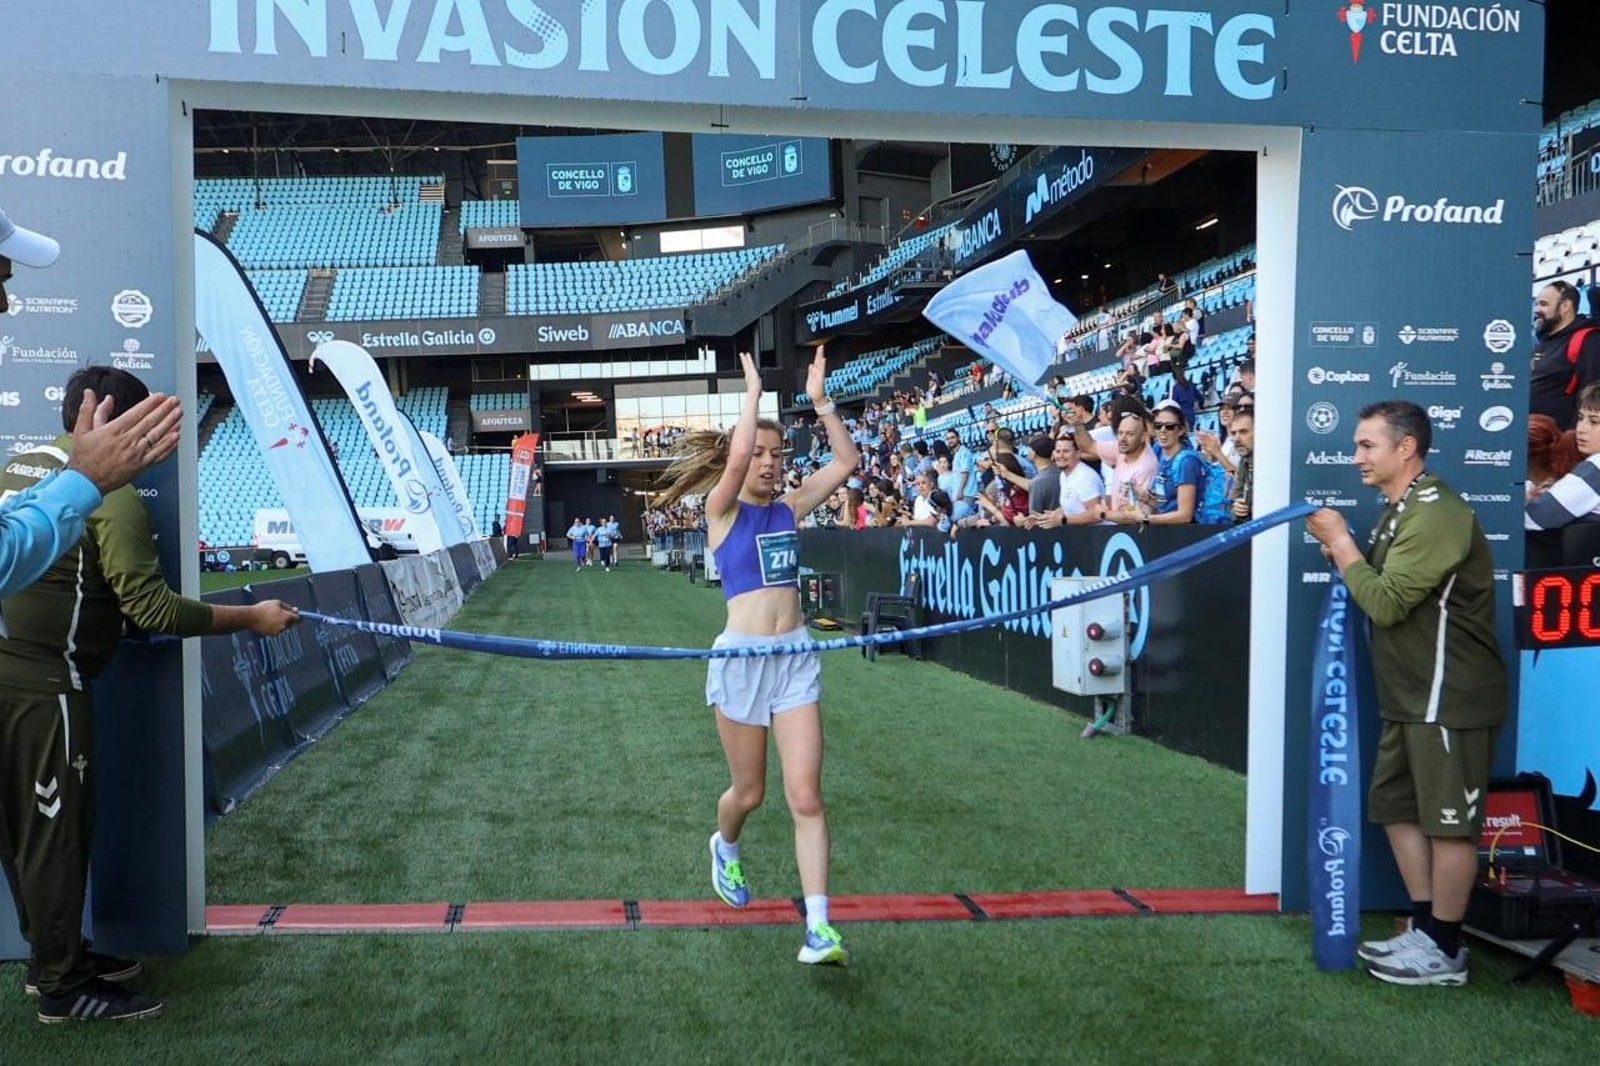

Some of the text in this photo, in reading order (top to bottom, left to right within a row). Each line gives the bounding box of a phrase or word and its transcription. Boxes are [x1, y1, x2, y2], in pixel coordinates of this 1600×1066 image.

[1382, 3, 1520, 33] FUNDACIÓN
[811, 0, 1278, 100] CELESTE
[1380, 30, 1458, 57] CELTA
[0, 148, 127, 180] rofand
[725, 152, 774, 168] CONCELLO
[551, 170, 604, 180] CONCELLO
[732, 164, 769, 178] DE VIGO
[1050, 149, 1094, 205] método
[558, 180, 599, 190] DE VIGO
[1383, 196, 1505, 224] Profand
[958, 207, 1002, 259] ABANCA
[820, 299, 859, 330] hummel
[361, 329, 474, 348] Estrella Galicia
[538, 325, 590, 343] Siweb
[1312, 326, 1355, 335] CONCELLO
[12, 346, 77, 359] Fundación
[1325, 370, 1370, 384] Coplaca
[1403, 370, 1457, 382] Fundación
[481, 415, 524, 426] AFOUTEZA
[1427, 405, 1462, 421] Giga
[1305, 451, 1355, 465] Adeslas
[1302, 573, 1331, 583] MR
[979, 538, 1082, 639] Galic
